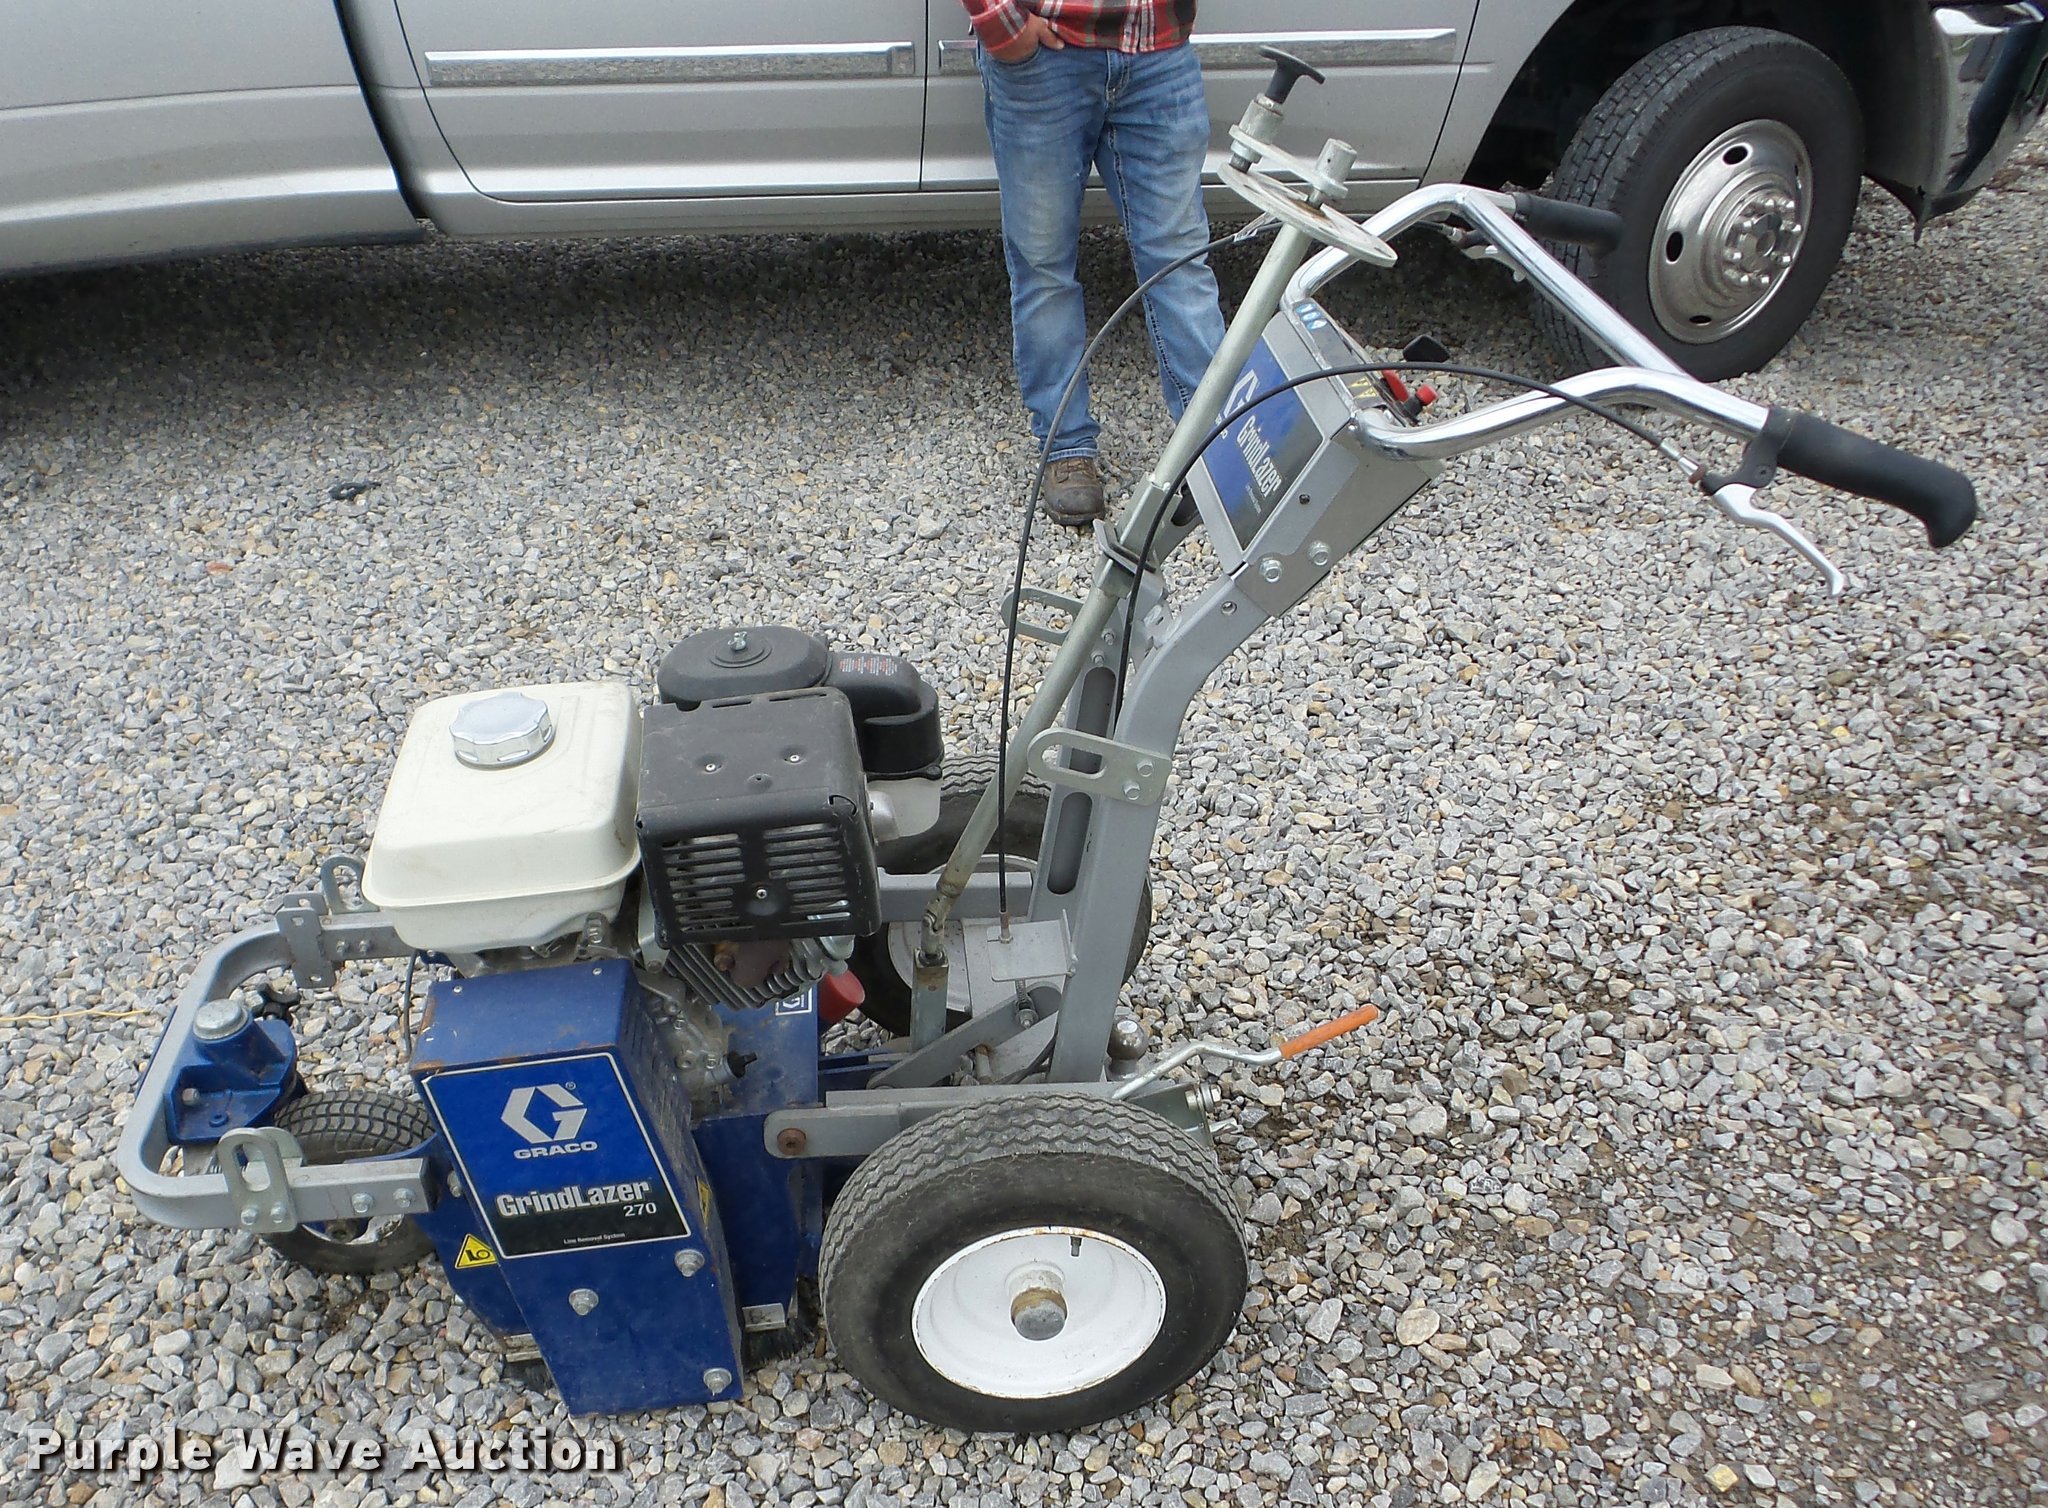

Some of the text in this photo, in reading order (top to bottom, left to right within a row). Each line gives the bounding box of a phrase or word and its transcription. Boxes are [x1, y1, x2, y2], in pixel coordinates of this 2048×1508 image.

[1236, 415, 1282, 497] GrindLazer
[513, 1141, 598, 1159] GRACO
[496, 1181, 650, 1218] GrindLazer
[623, 1202, 657, 1217] 270
[603, 1232, 626, 1240] System
